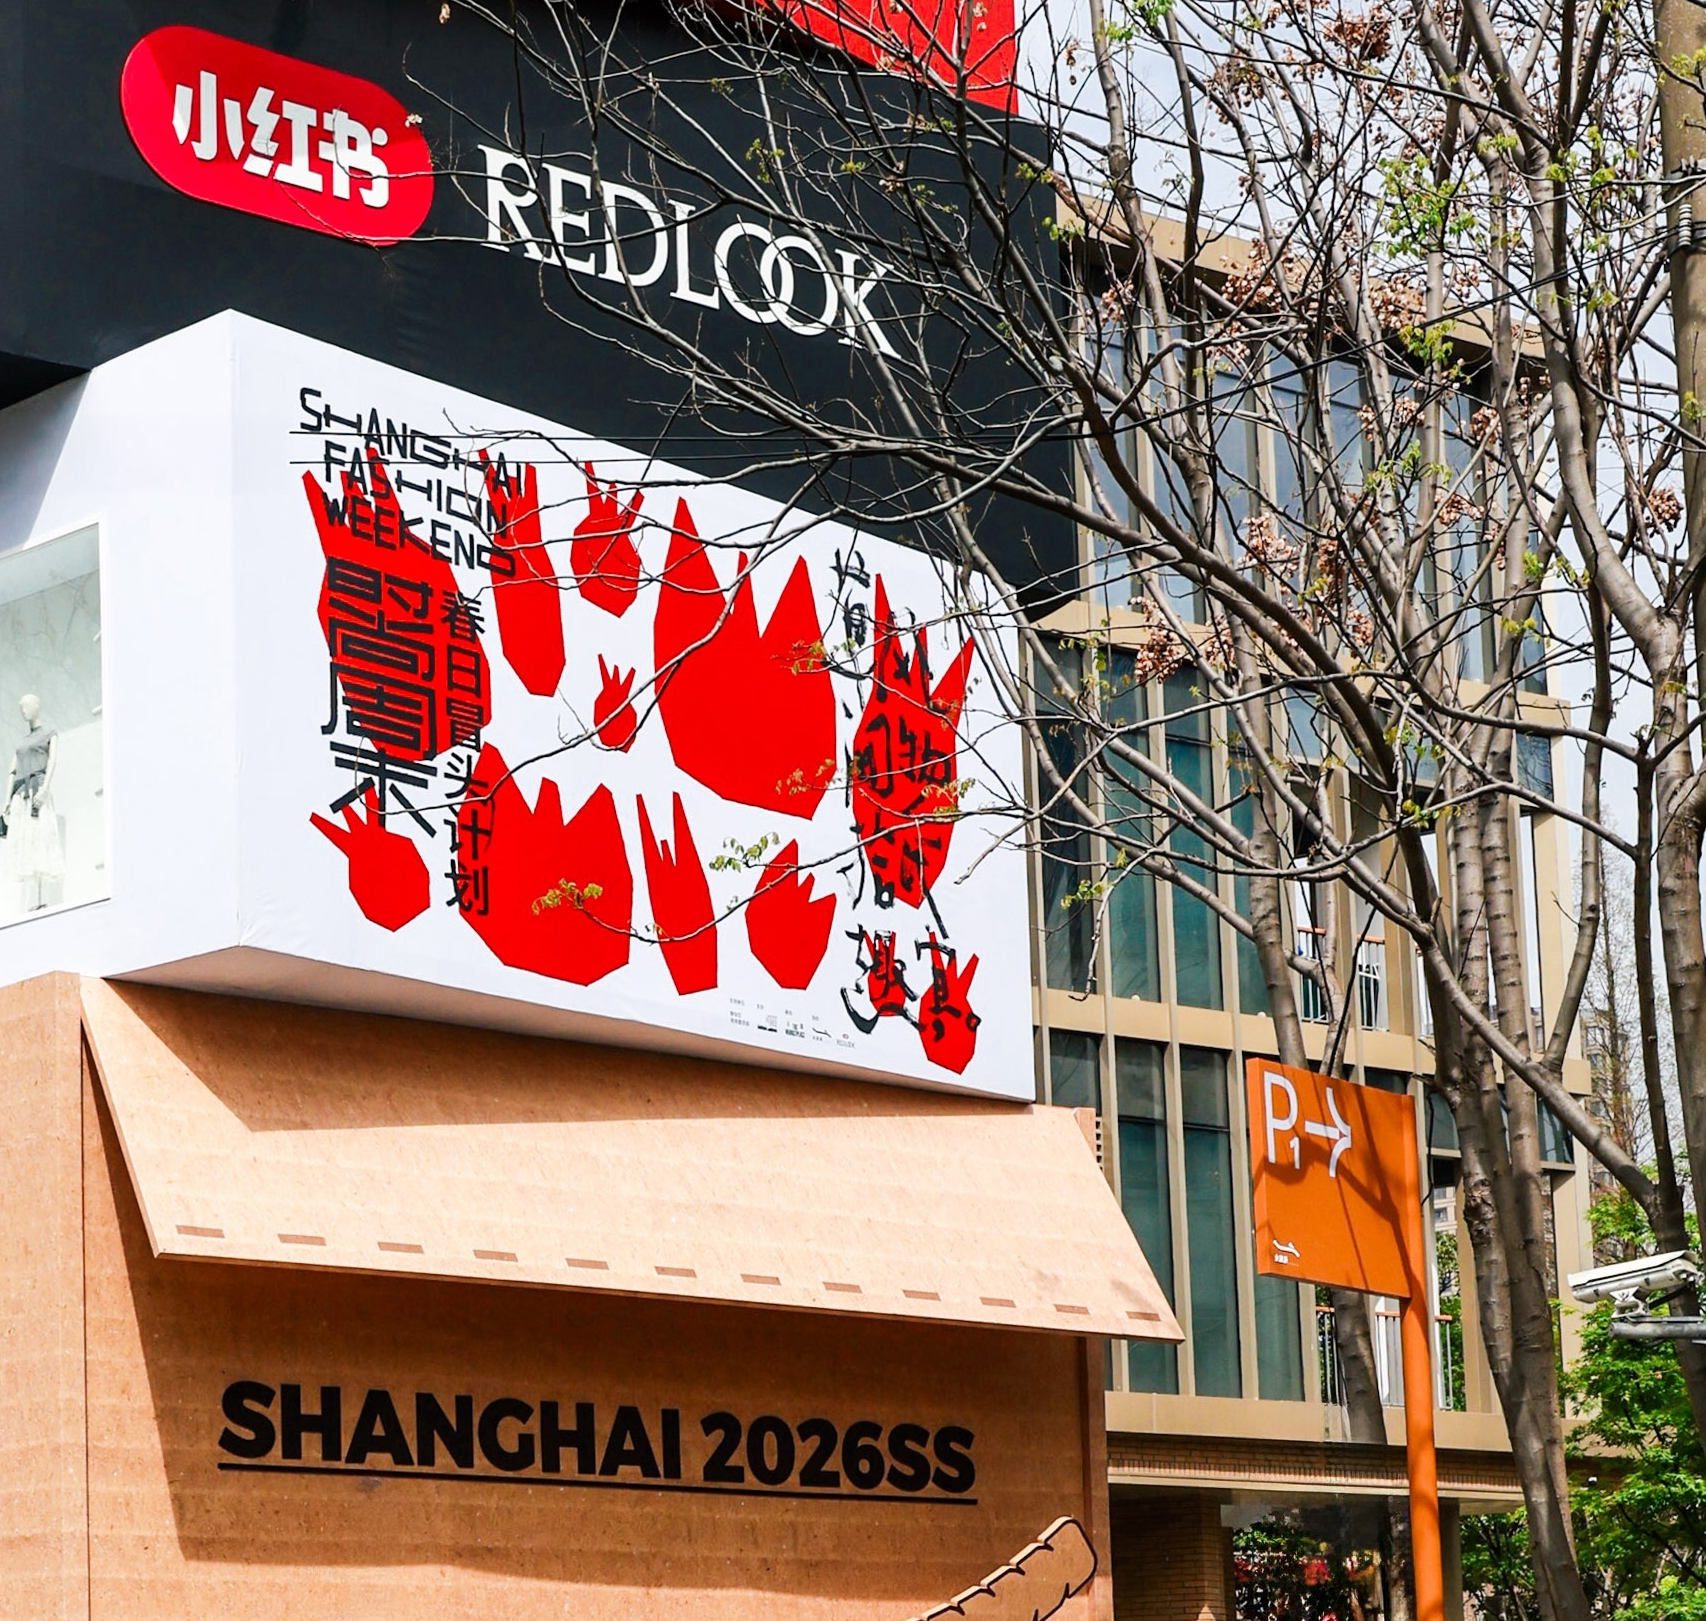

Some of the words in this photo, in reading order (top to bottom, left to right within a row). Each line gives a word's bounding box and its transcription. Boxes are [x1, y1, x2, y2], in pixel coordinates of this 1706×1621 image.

[172, 69, 389, 209] 小红书
[477, 144, 902, 361] REDLOOK
[300, 387, 523, 498] SHANGHAI
[324, 440, 507, 539] FASHION
[322, 491, 516, 577] WEEKEND
[217, 1380, 682, 1480] SHANGHAI
[699, 1411, 977, 1494] 2026SS
